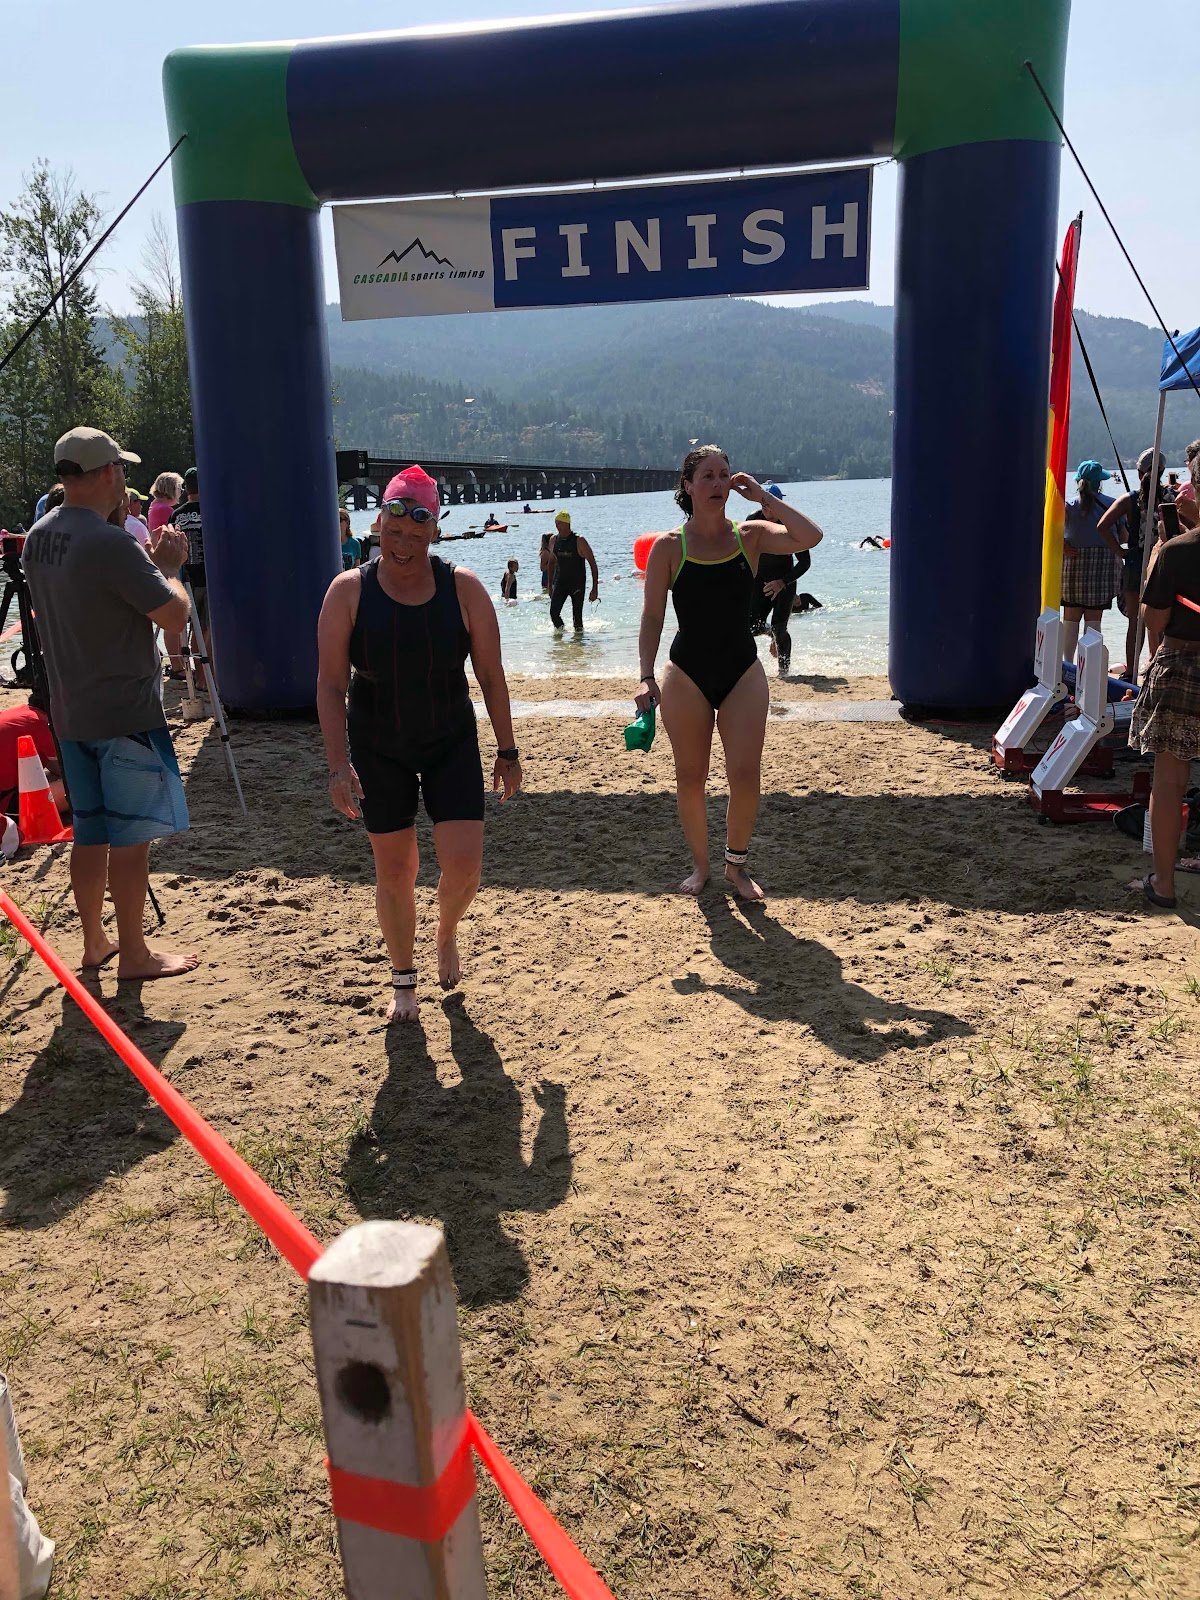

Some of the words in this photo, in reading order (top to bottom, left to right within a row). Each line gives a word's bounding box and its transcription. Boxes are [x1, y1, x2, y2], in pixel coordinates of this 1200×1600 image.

[501, 202, 860, 281] FINISH
[353, 271, 409, 284] CASCADIA
[410, 271, 445, 281] sports
[448, 270, 485, 280] timing
